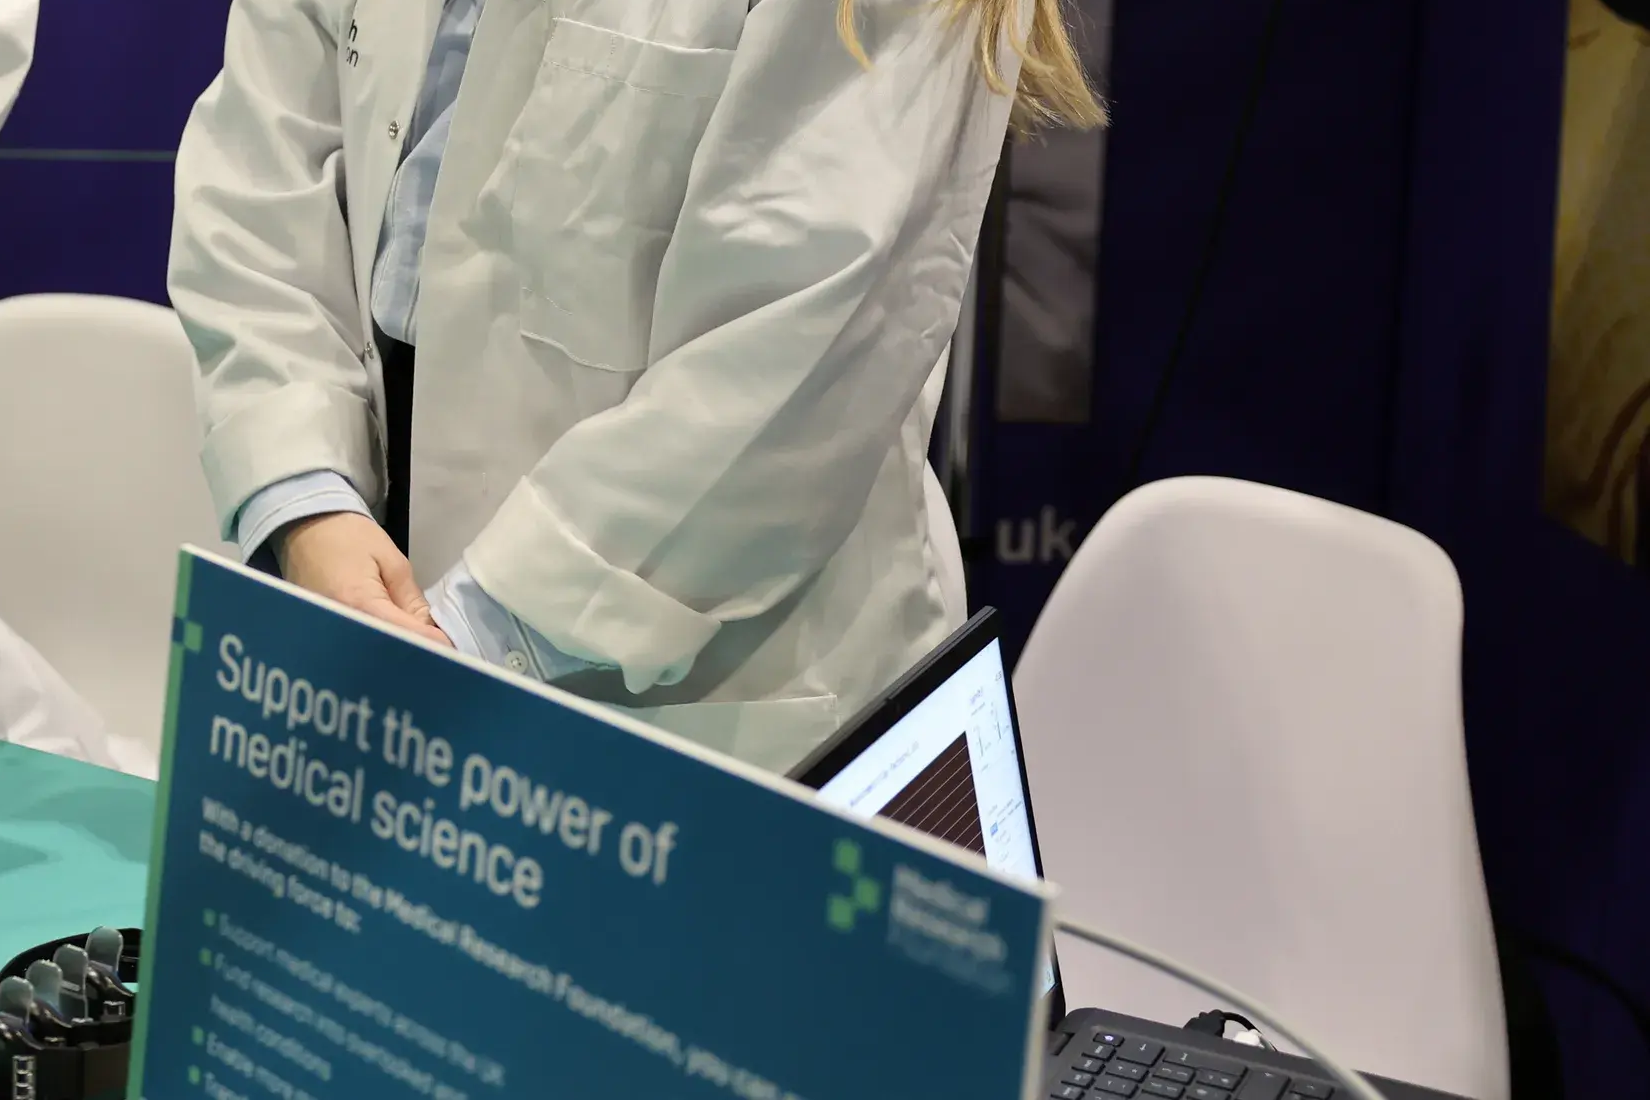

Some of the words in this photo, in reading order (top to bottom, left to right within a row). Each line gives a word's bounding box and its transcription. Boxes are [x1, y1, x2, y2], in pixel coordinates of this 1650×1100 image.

[994, 504, 1078, 565] uk
[209, 714, 365, 825] medical
[370, 789, 544, 910] science
[216, 633, 374, 753] Support
[382, 705, 453, 787] the
[459, 752, 614, 856] power
[618, 820, 680, 886] of
[384, 887, 459, 945] Medical
